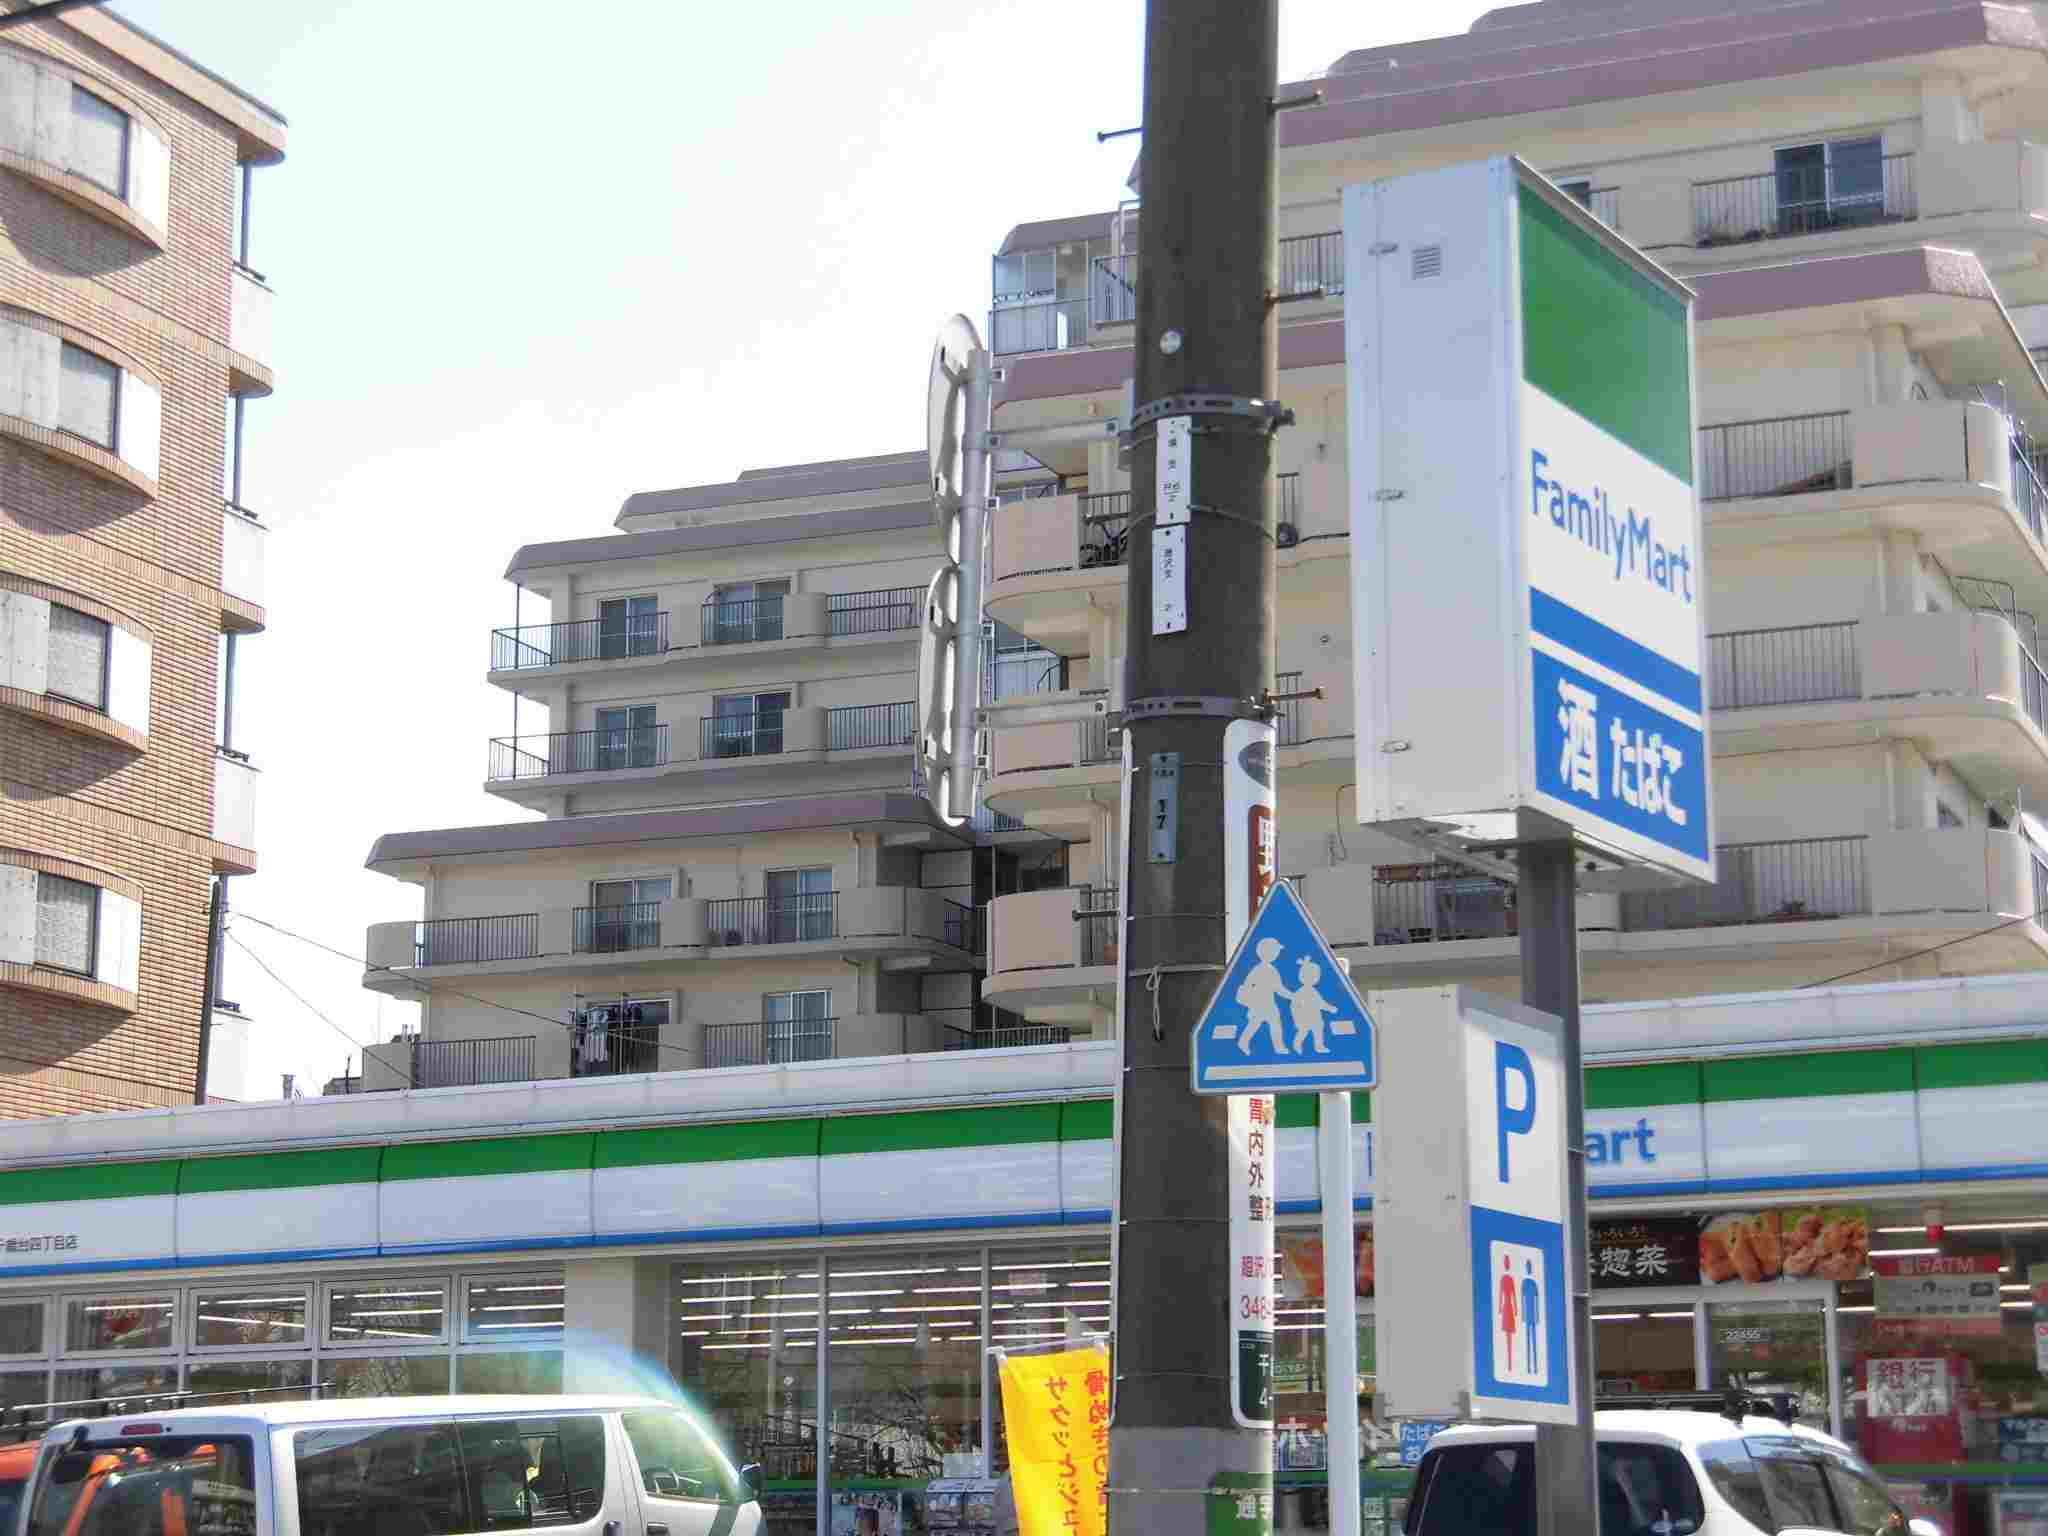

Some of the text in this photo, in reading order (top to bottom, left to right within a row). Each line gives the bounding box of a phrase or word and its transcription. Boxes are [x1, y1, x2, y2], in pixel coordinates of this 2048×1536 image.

[1531, 447, 1691, 603] FamilyMart
[1557, 677, 1687, 826] 酒 たばこ
[1494, 1039, 1537, 1184] P
[1588, 1243, 1668, 1277] 惣菜
